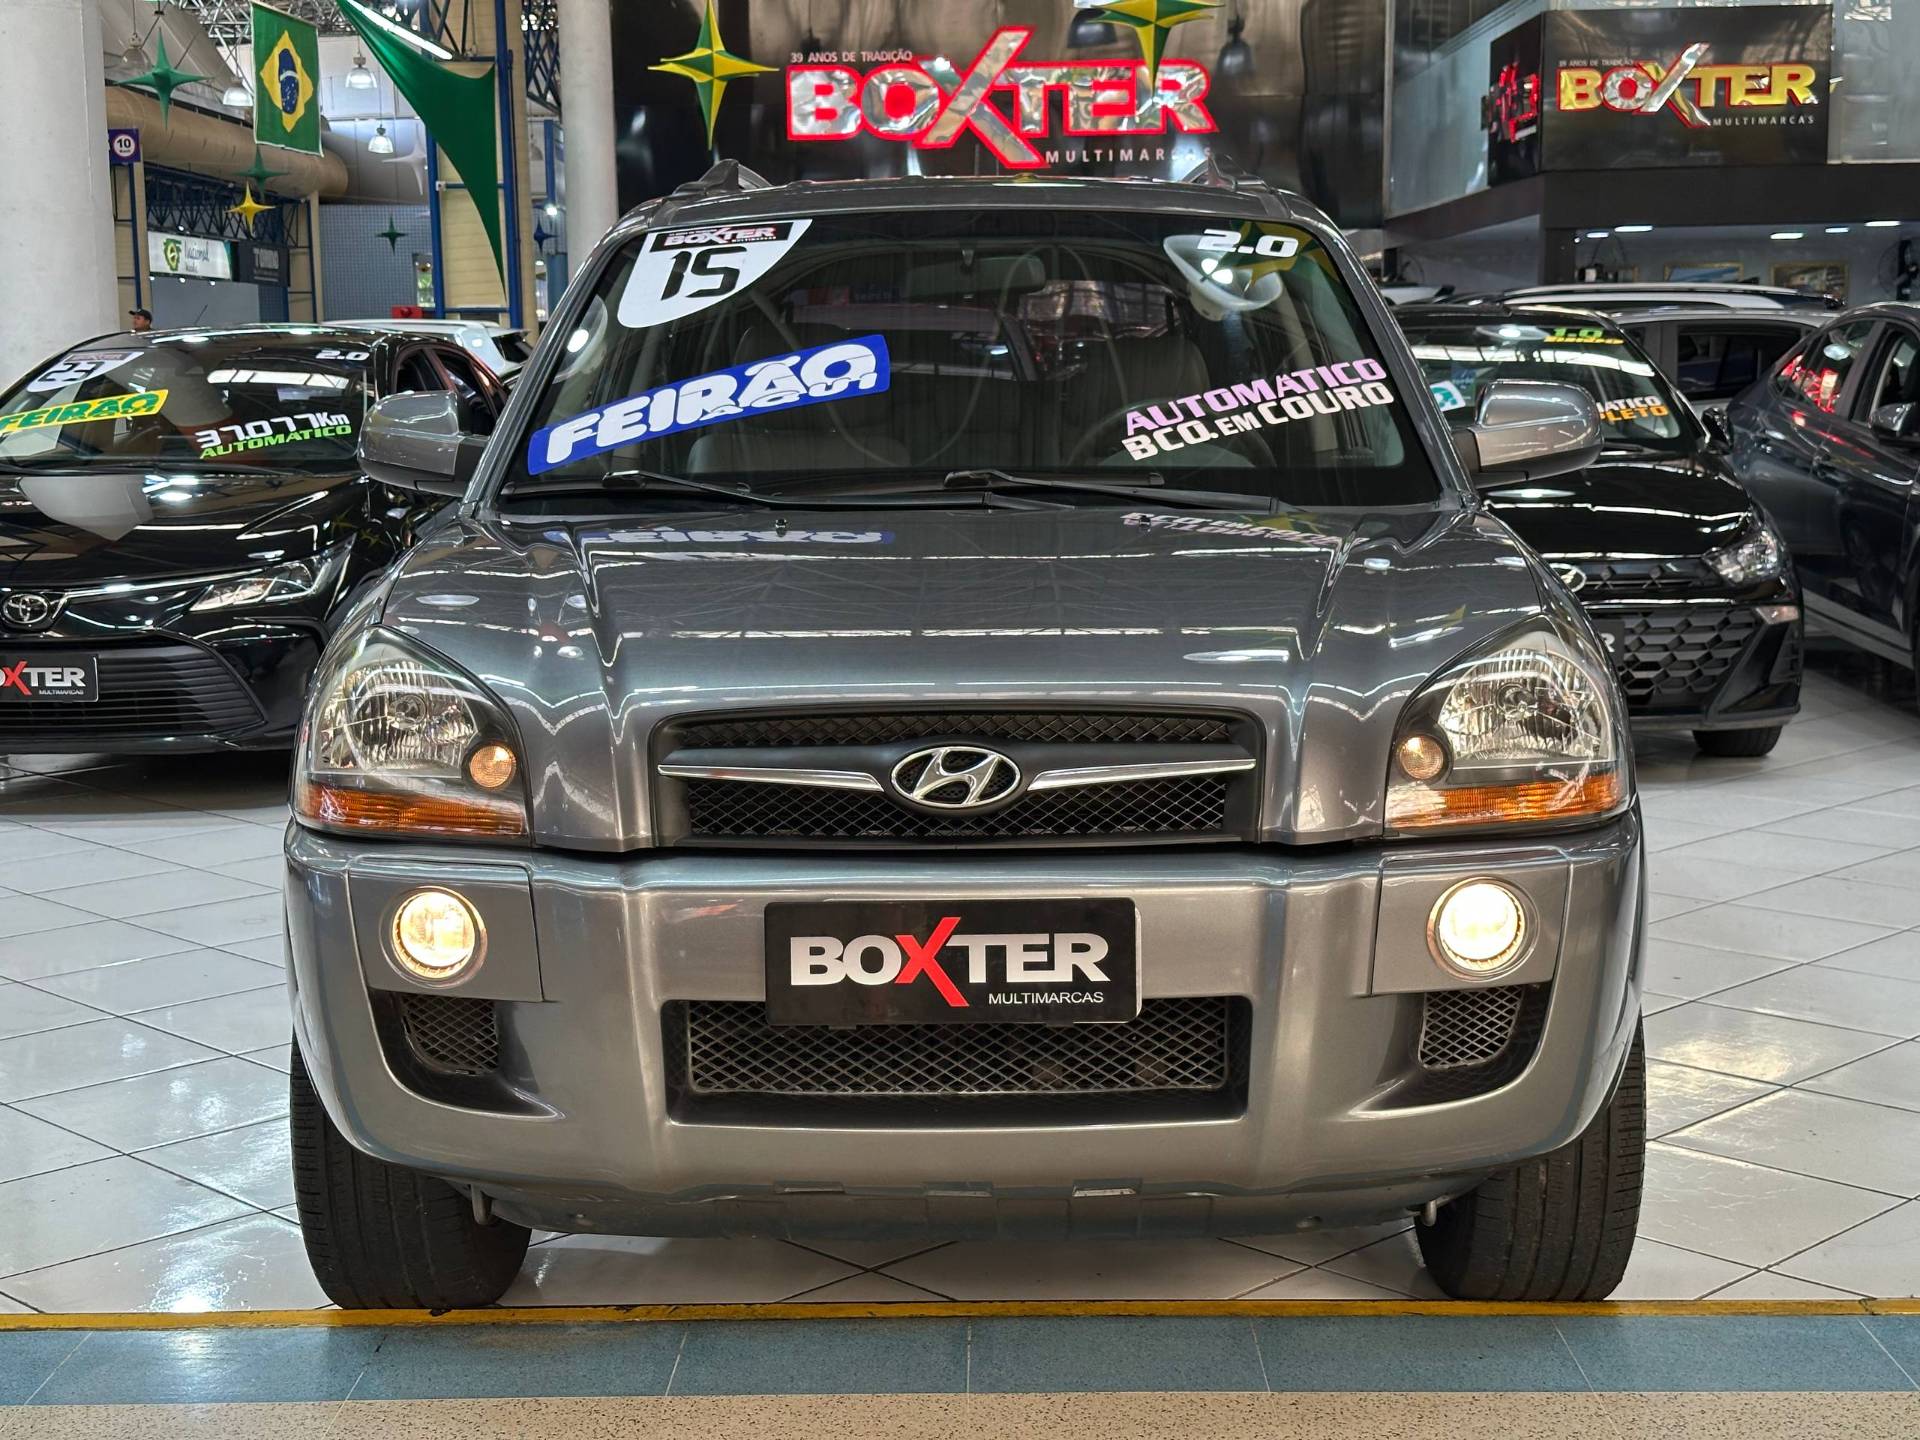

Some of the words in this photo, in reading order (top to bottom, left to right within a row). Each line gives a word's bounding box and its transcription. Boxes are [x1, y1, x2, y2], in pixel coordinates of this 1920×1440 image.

[790, 52, 804, 63] 39
[807, 52, 838, 63] ANOS
[842, 52, 857, 63] DE
[861, 48, 913, 64] TRADIÇÃO
[787, 25, 1219, 169] BOXTER
[1556, 42, 1818, 128] BOXTER
[1712, 114, 1816, 127] MULTIMARCAS
[116, 138, 132, 149] 10
[663, 226, 777, 247] BOXTER
[1197, 228, 1299, 258] 2.0
[660, 246, 748, 301] 15
[315, 349, 370, 361] 2.0
[546, 343, 877, 464] FEIRÃO
[1214, 411, 1262, 437] EM
[1257, 382, 1395, 426] COURO
[0, 660, 86, 695] XTER
[790, 916, 1111, 1007] BOXTER
[988, 991, 1105, 1005] MULTIMARCAS
